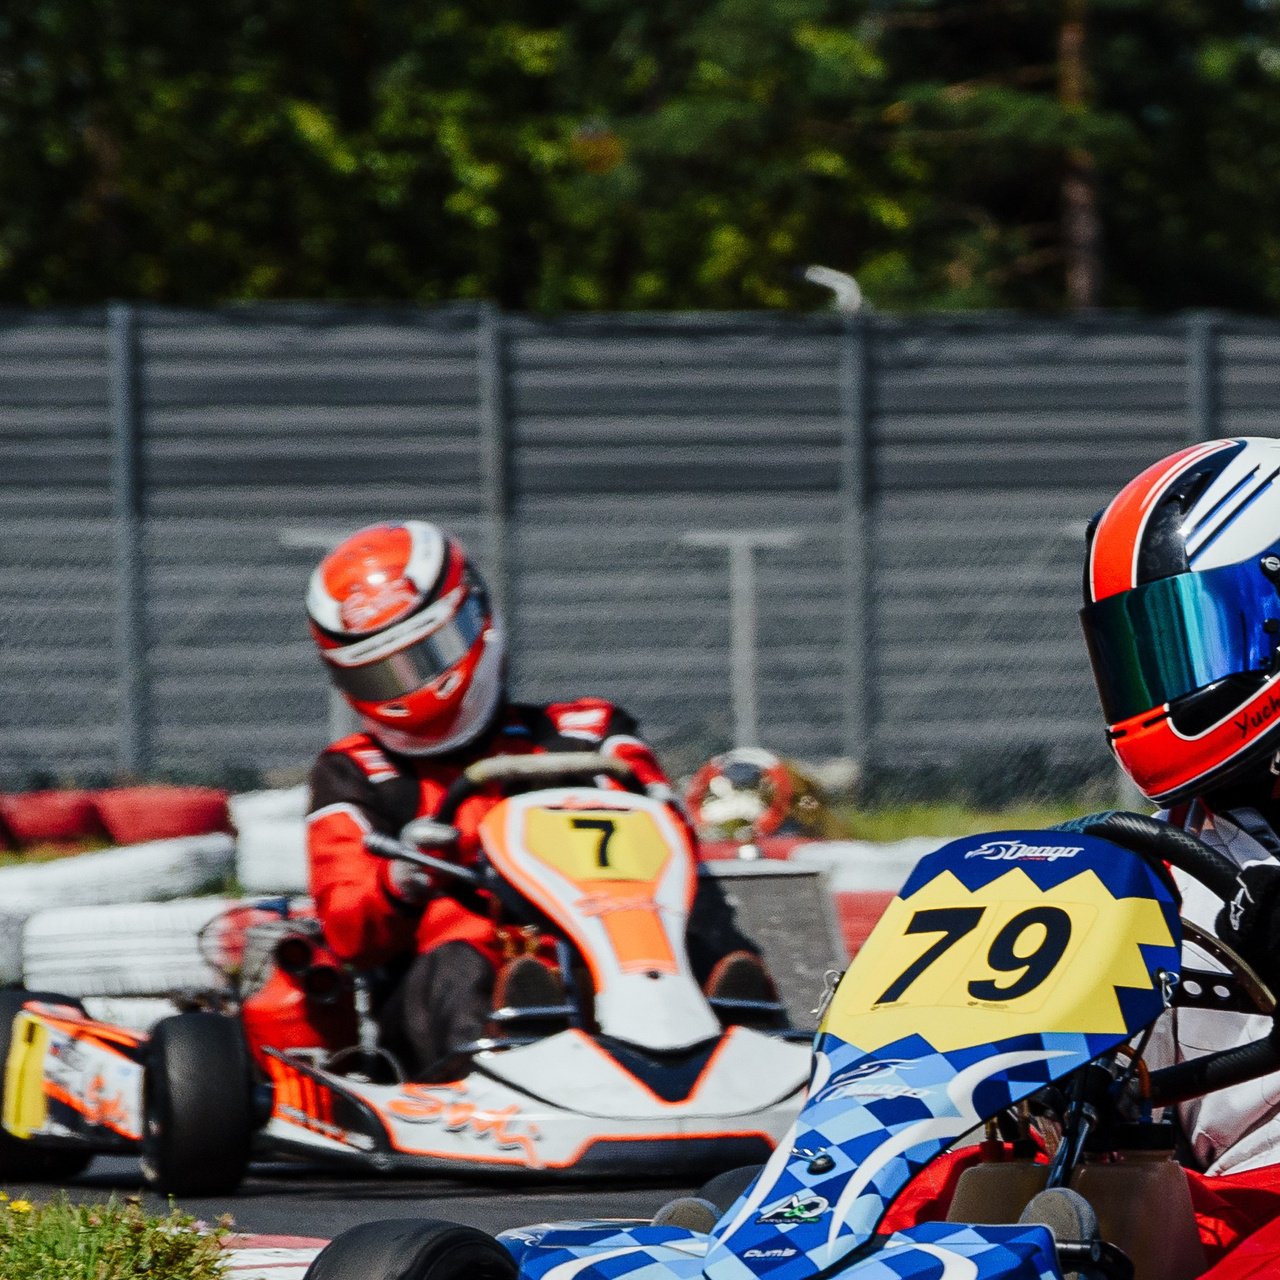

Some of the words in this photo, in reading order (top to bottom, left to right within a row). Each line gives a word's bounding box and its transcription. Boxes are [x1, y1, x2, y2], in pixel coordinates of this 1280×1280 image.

[569, 818, 615, 868] 7
[1003, 843, 1085, 862] Drago
[873, 905, 1073, 1005] 79
